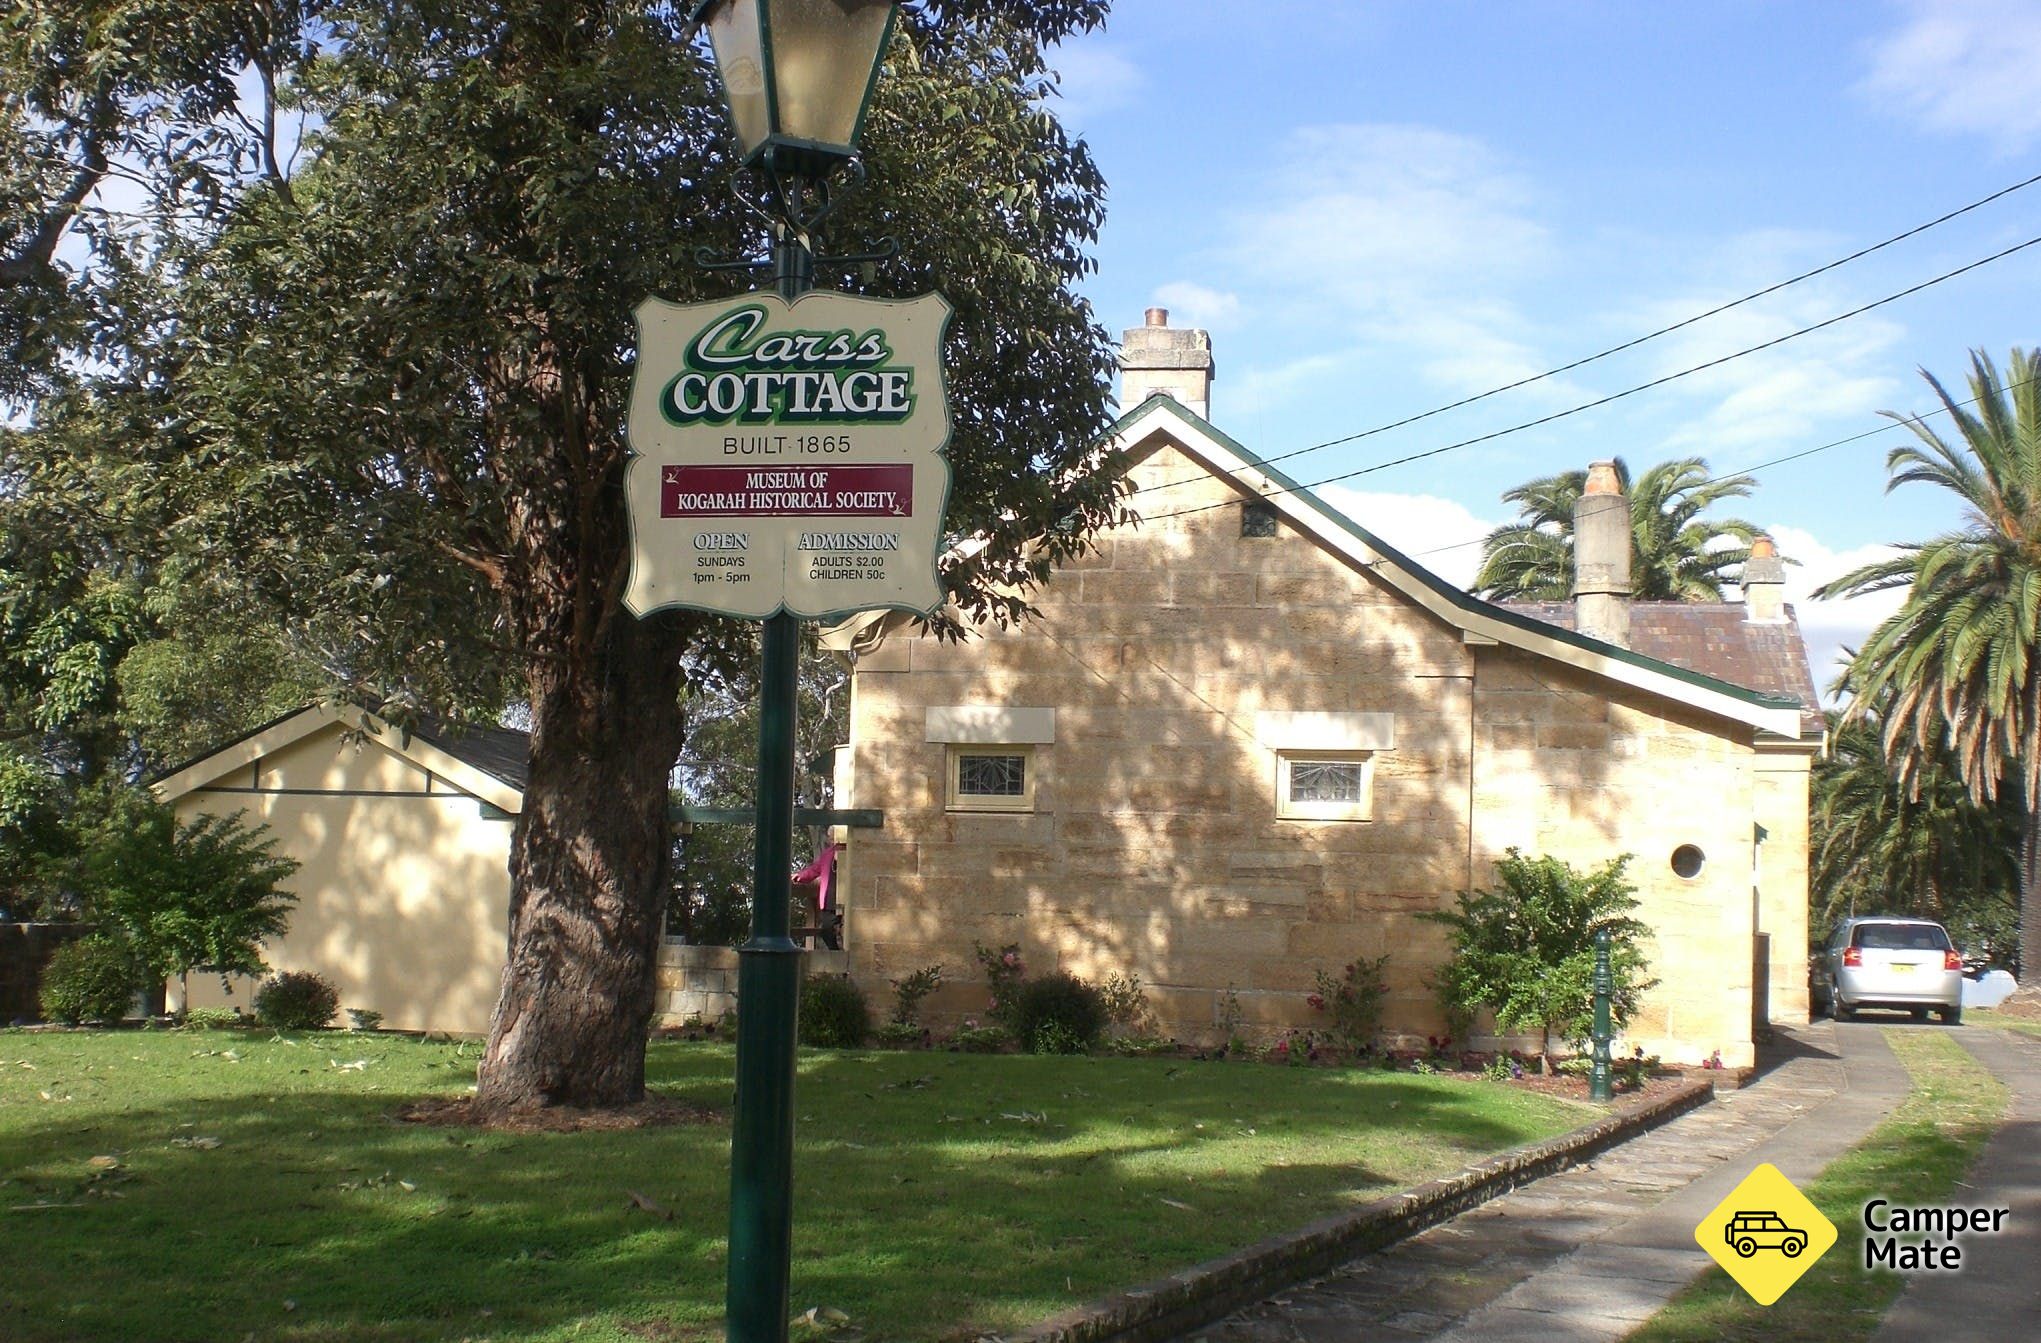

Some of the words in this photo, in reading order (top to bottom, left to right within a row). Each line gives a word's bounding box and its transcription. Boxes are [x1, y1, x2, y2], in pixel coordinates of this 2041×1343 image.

[697, 309, 888, 363] Carss
[673, 372, 910, 414] COTTAGE
[723, 437, 787, 455] BUILT
[797, 436, 851, 453] 1865
[746, 472, 805, 489] MUSEUM
[809, 472, 828, 488] OF
[678, 494, 746, 510] KOGARAH
[750, 492, 832, 508] HISTORICAL
[836, 491, 897, 508] SOCIETY
[694, 533, 749, 550] OPEN
[799, 533, 899, 550] ADMISSION
[697, 556, 745, 567] SUNDAYS
[812, 556, 852, 567] ADULTS
[856, 556, 884, 568] $2.00
[693, 572, 715, 584] 1pm
[726, 572, 750, 584] 5pm
[809, 569, 863, 580] CHILDREN
[866, 569, 885, 580] 50c
